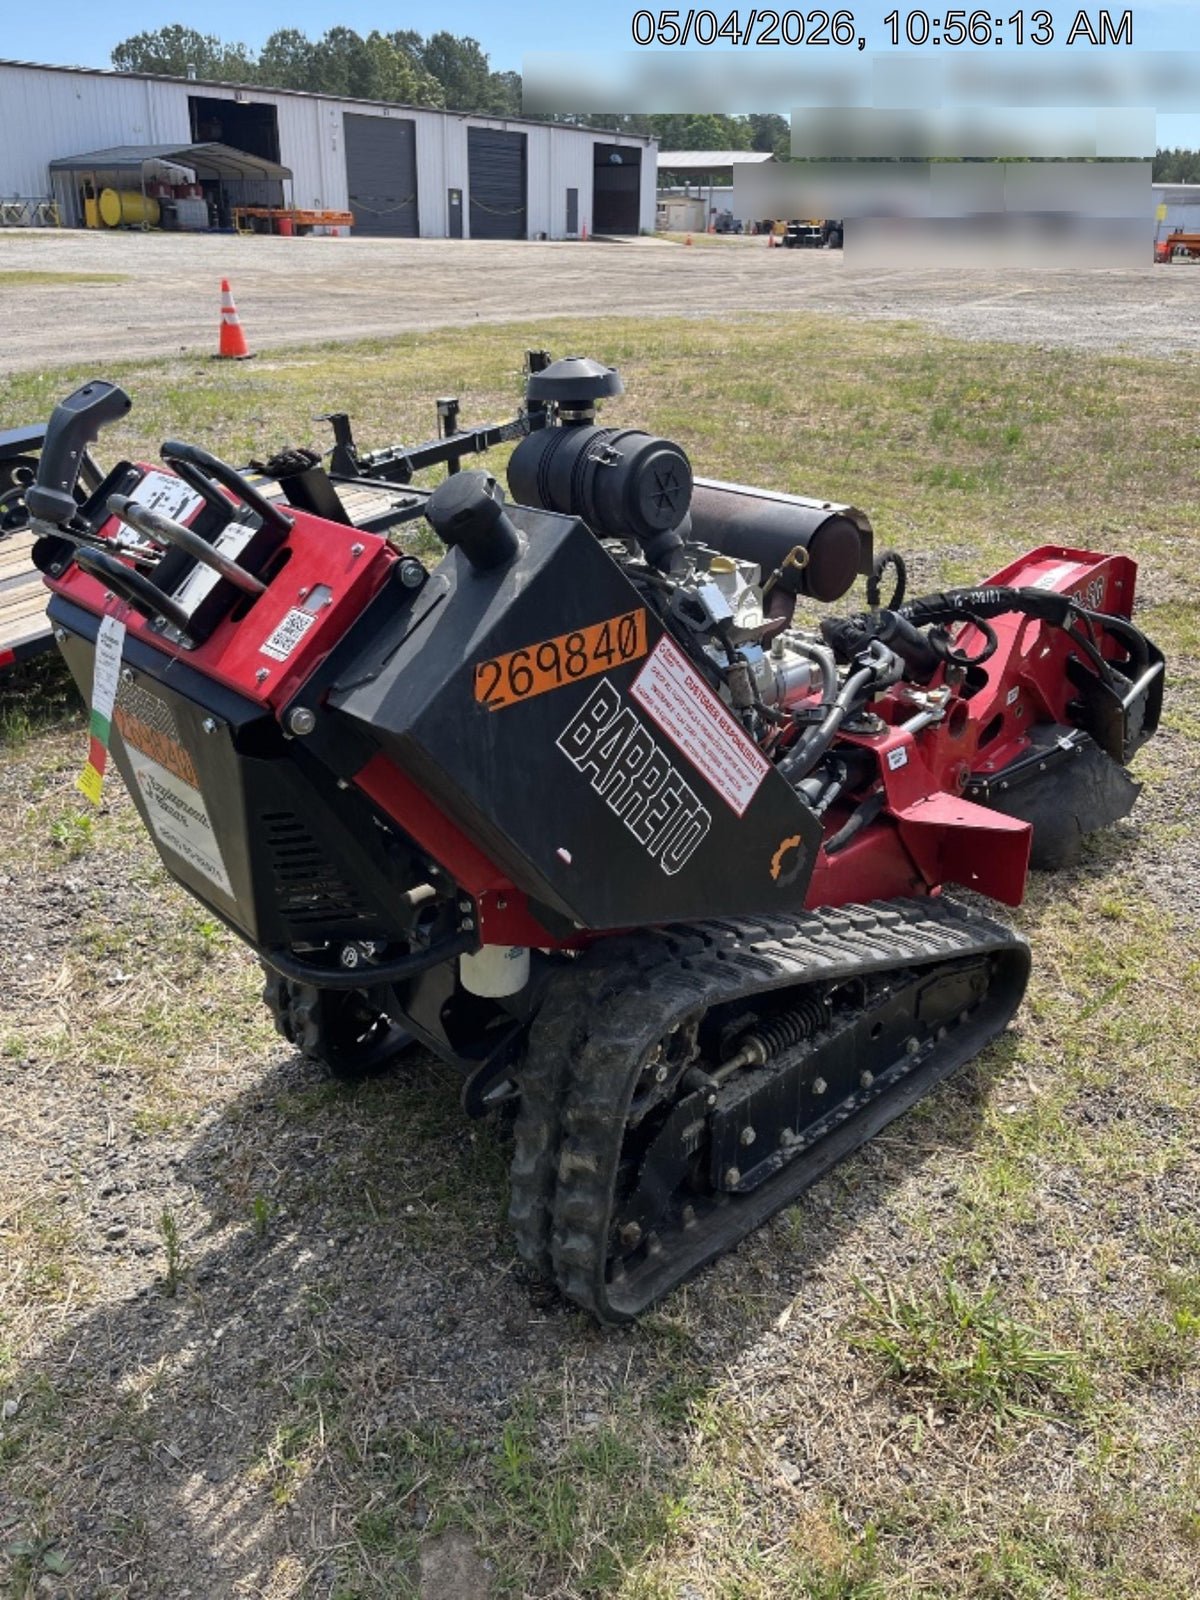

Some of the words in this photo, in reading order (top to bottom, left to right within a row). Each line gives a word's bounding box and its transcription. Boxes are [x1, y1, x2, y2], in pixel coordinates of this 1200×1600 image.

[477, 615, 639, 704] 269840
[684, 674, 720, 721] CUSTOMER
[717, 714, 767, 776] RESPONSIBILITY
[555, 676, 713, 877] BARRETO
